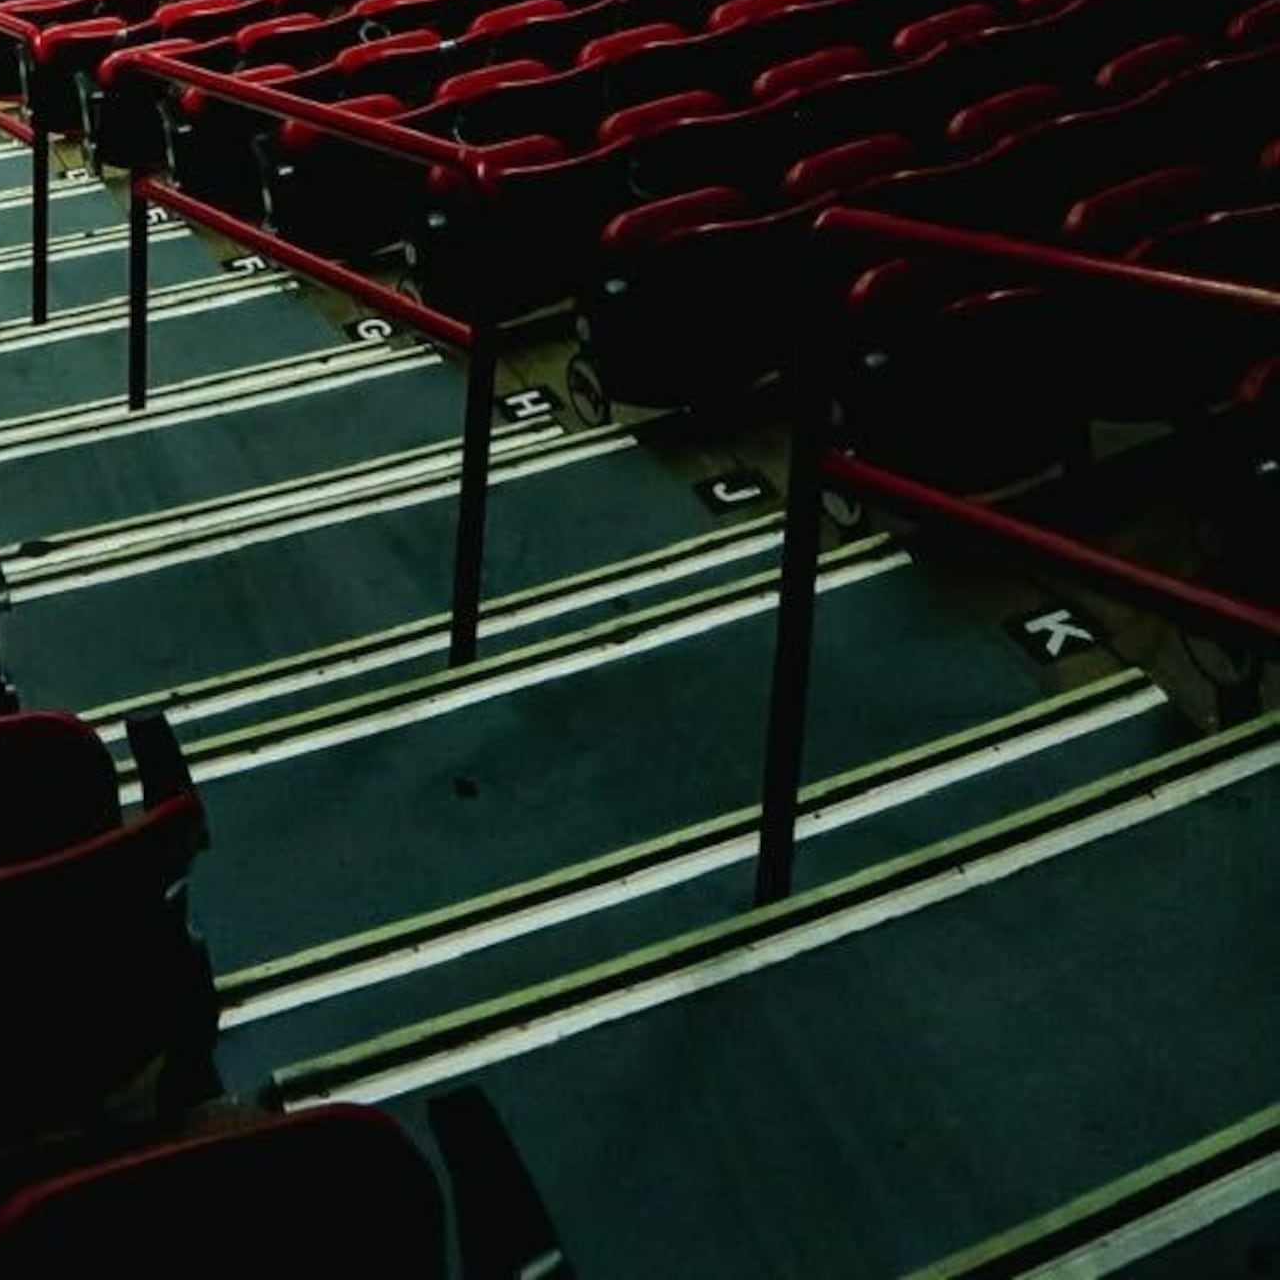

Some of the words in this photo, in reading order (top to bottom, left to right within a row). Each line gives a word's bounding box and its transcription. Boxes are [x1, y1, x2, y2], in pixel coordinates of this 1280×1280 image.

[231, 255, 266, 275] F
[356, 317, 392, 350] G
[505, 390, 552, 419] H
[712, 481, 762, 503] J
[1023, 608, 1095, 657] K
